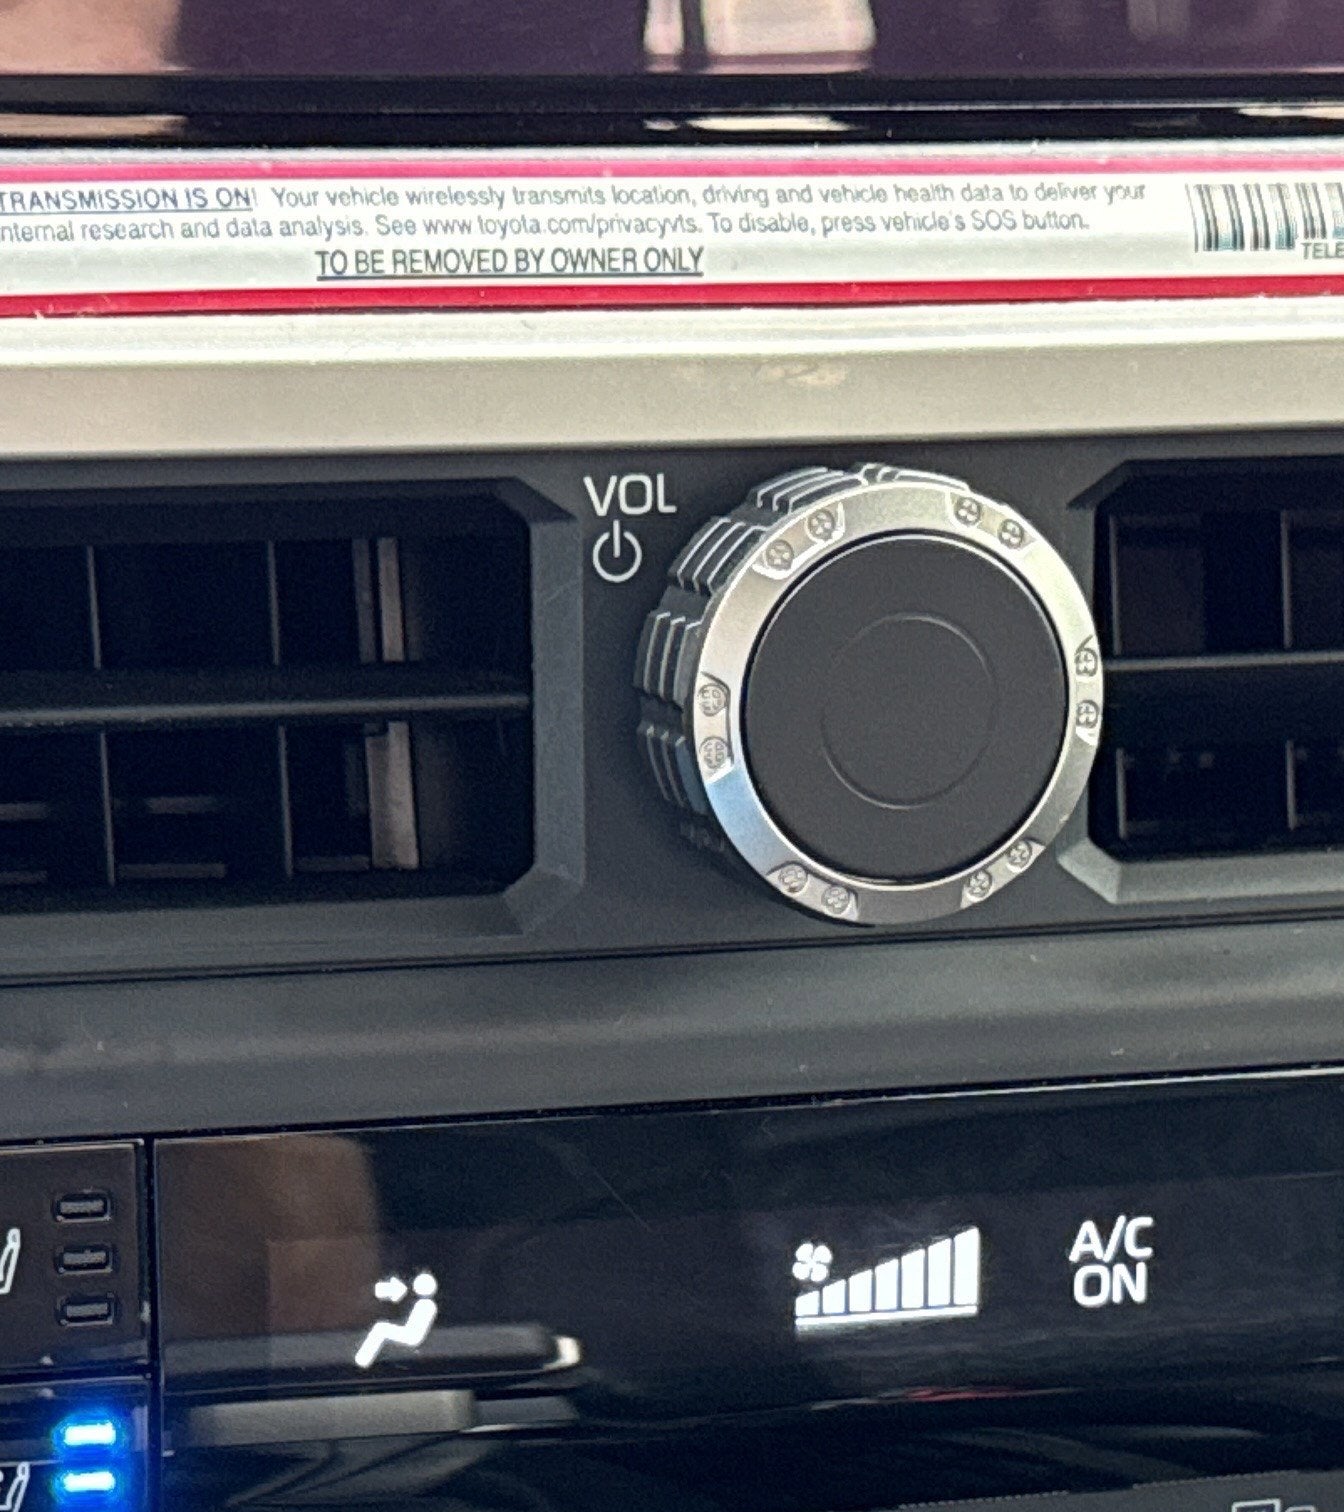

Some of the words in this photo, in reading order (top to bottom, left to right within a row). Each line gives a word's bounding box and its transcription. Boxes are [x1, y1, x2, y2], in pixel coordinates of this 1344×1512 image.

[184, 187, 207, 208] IS
[271, 187, 319, 207] Your
[325, 186, 399, 206] vehicle
[406, 186, 505, 209] wirelessly
[512, 186, 605, 205] transmits
[612, 185, 696, 207] location,
[703, 184, 768, 208] driving
[776, 184, 813, 204] and
[819, 183, 888, 203] vehicle
[893, 183, 955, 202] health
[960, 183, 1004, 202] data
[1009, 183, 1028, 202] to
[1035, 183, 1097, 202] deliver
[1103, 184, 1146, 207] your
[81, 218, 175, 240] research
[181, 216, 220, 239] and
[227, 214, 273, 237] data
[279, 214, 368, 242] analysis.
[375, 214, 417, 235] See
[707, 213, 733, 234] To
[739, 212, 816, 235] disable,
[822, 214, 876, 236] press
[882, 211, 966, 231] vehicle's
[971, 210, 1016, 229] SOS
[1023, 210, 1090, 230] button.
[316, 250, 348, 275] TO
[355, 249, 385, 274] BE
[393, 248, 508, 273] REMOVED
[516, 248, 544, 273] BY
[551, 248, 638, 272] OWNER
[644, 246, 704, 272] ONLY
[584, 472, 676, 516] VOL
[1069, 1216, 1155, 1262] A/C
[1073, 1262, 1147, 1308] ON
